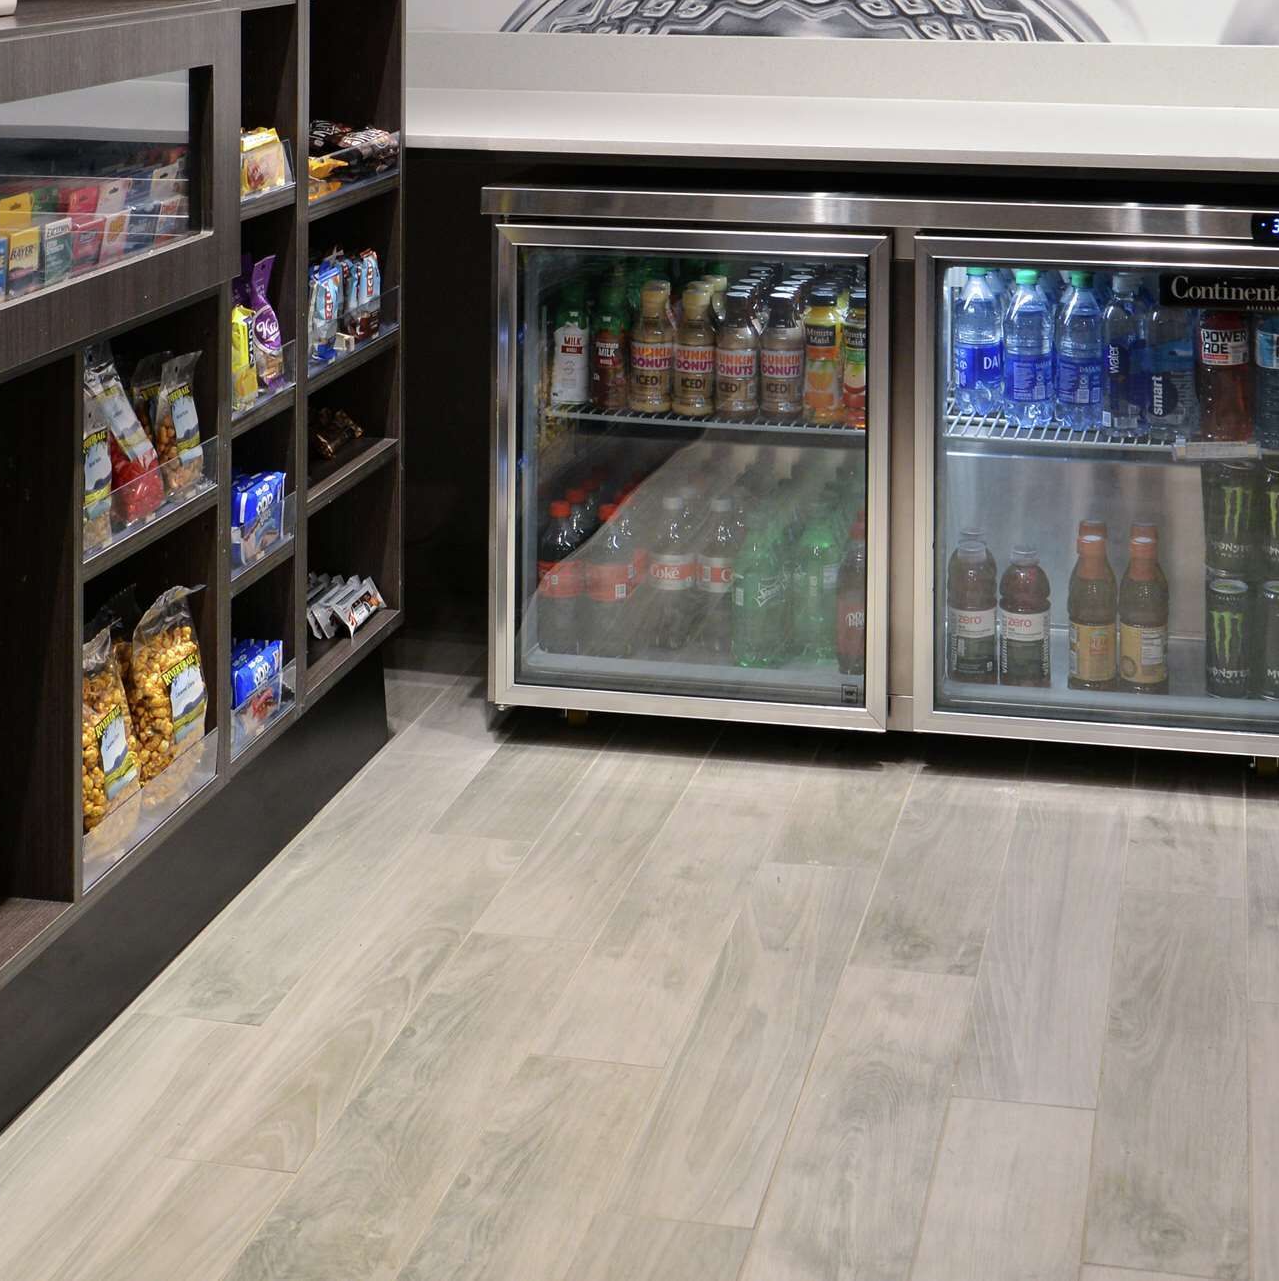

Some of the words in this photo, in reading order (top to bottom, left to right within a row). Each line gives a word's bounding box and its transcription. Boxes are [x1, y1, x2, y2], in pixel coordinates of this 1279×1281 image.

[10, 244, 35, 260] BAYER
[564, 336, 582, 345] MILK
[1202, 330, 1248, 343] POWER
[599, 348, 617, 358] MILK
[1203, 344, 1228, 355] ADE
[1109, 344, 1119, 374] water
[1151, 375, 1163, 417] smart
[1007, 616, 1032, 628] zero
